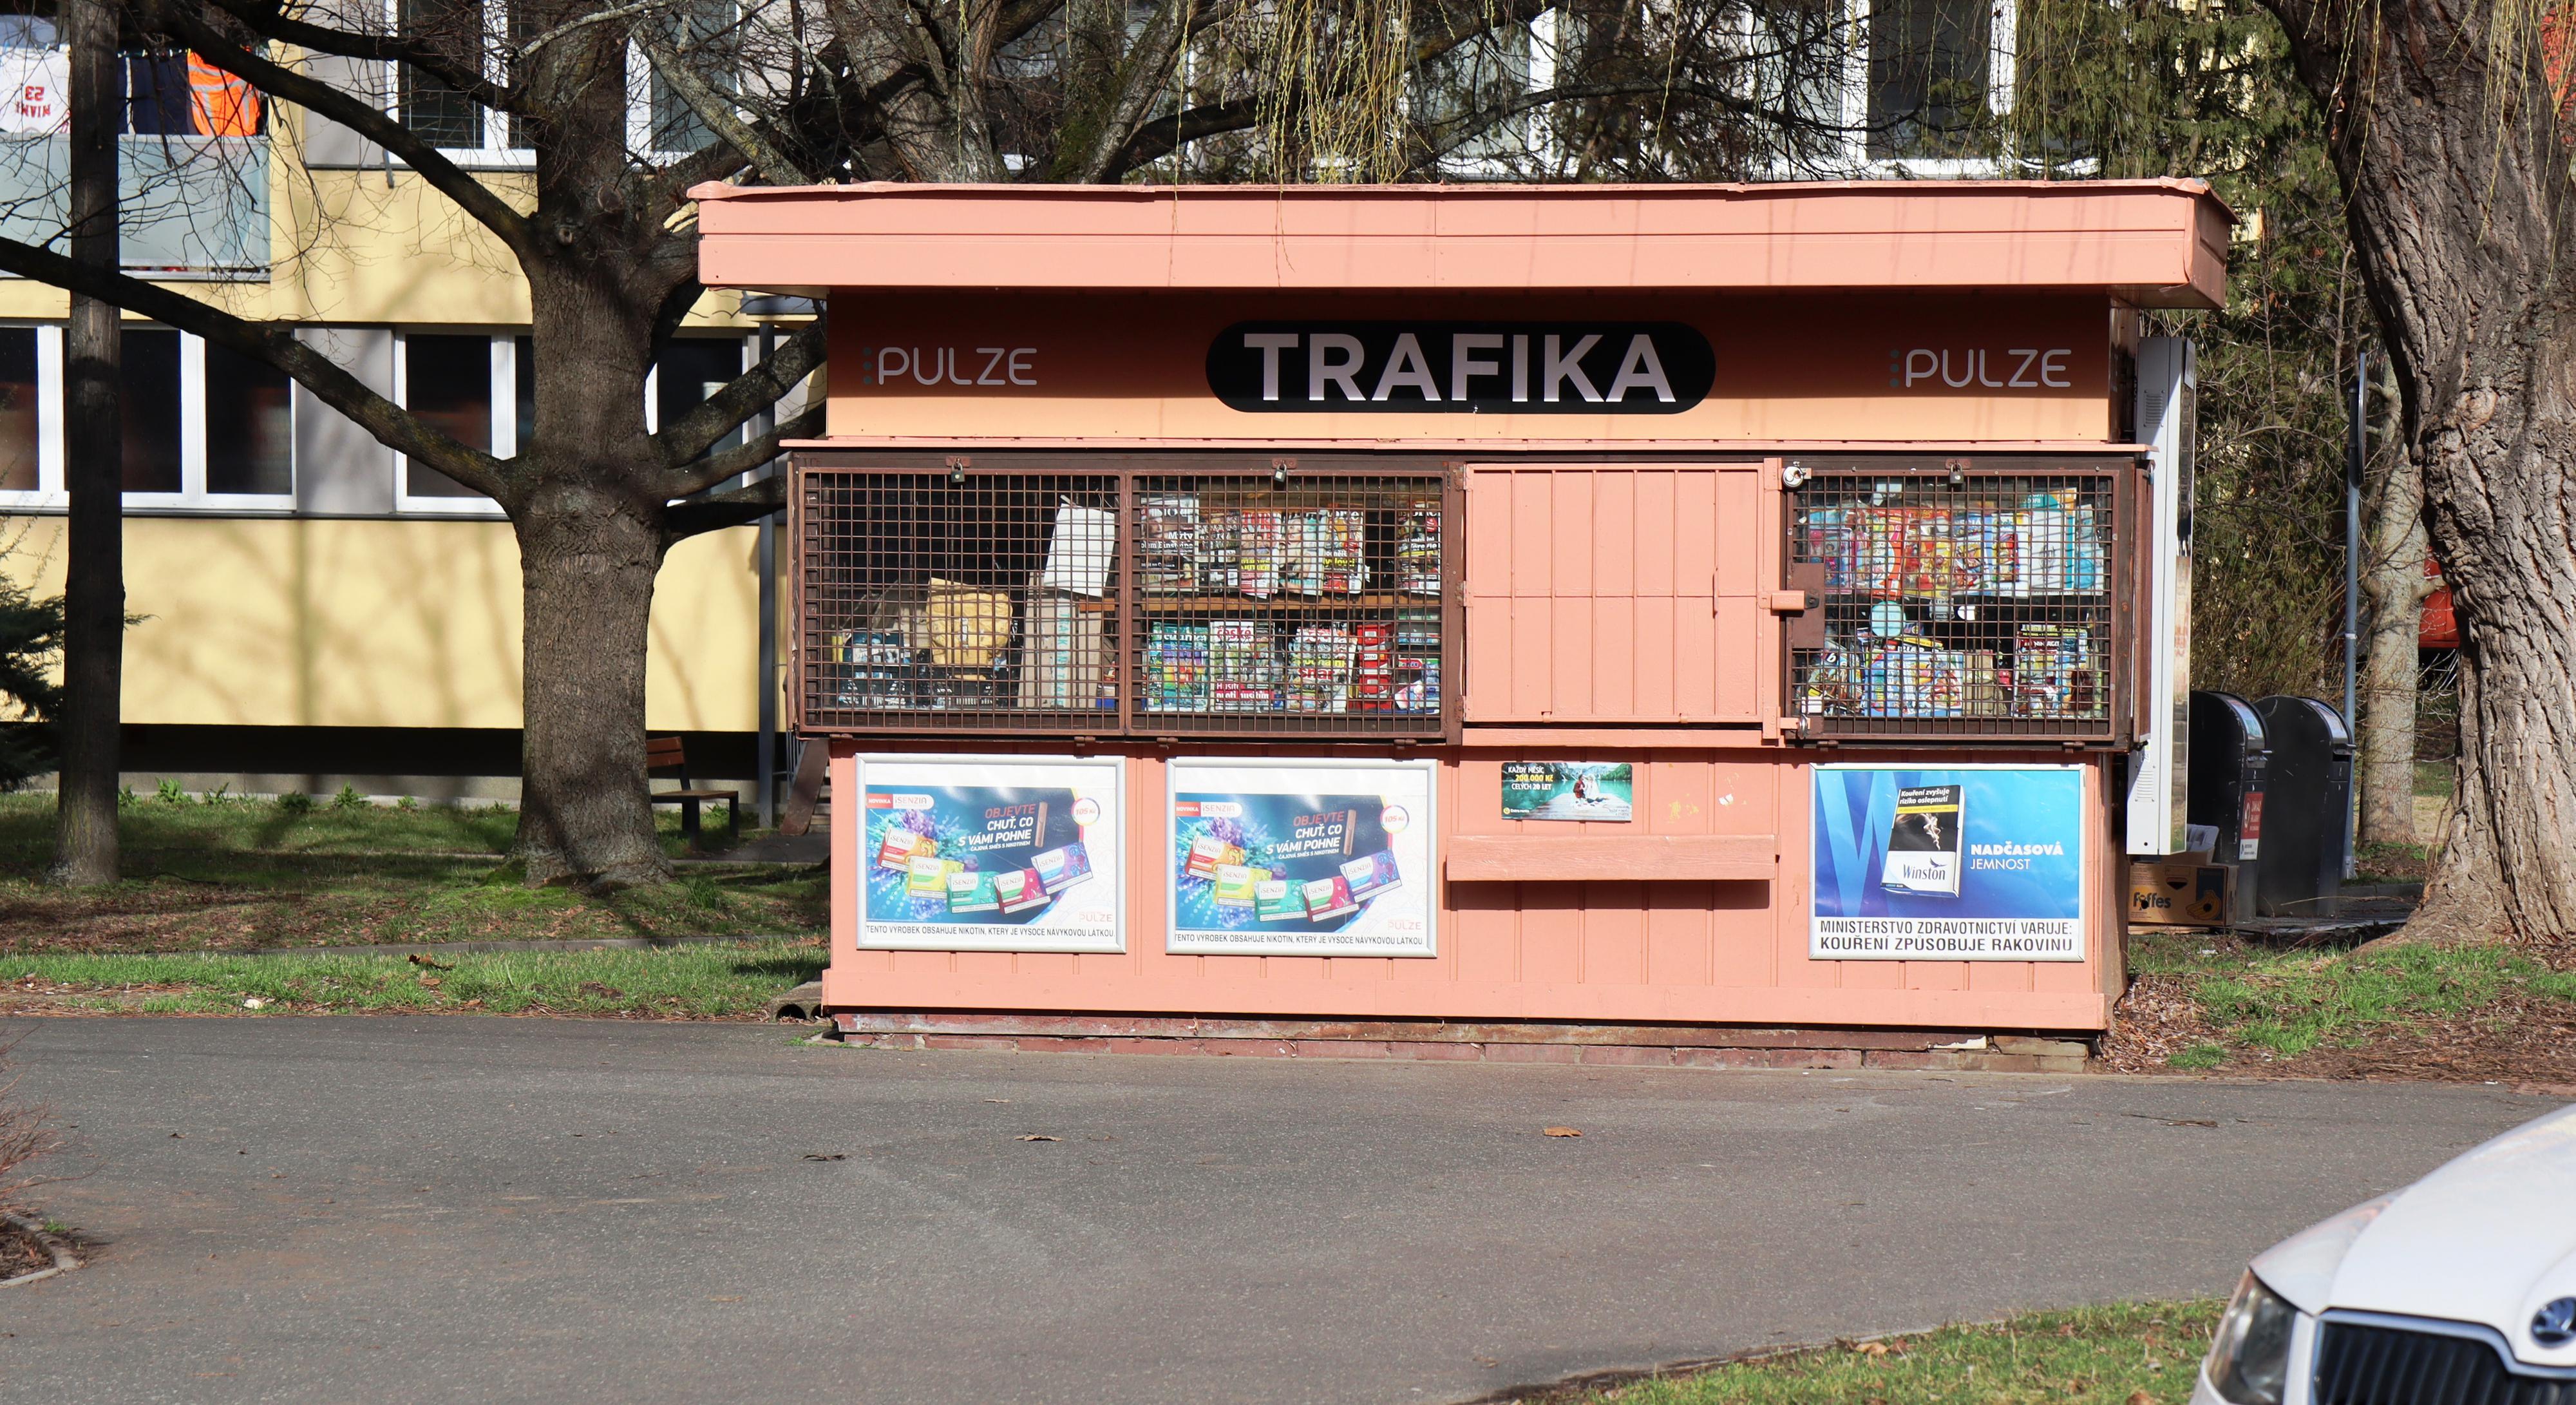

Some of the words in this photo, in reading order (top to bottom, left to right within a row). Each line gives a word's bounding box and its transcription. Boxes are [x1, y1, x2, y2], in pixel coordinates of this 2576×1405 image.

[24, 86, 44, 101] 23
[878, 347, 1037, 385] PULZE
[1244, 333, 1676, 403] TRAFIKA
[1906, 349, 2071, 388] PULZE
[1917, 796, 1949, 805] oslepnutí
[985, 804, 1036, 819] OBJEVTE
[1293, 811, 1345, 827] OBJEVTE
[987, 816, 1016, 831] CHUŤ,
[1019, 817, 1034, 827] CO
[958, 837, 965, 846] S
[969, 832, 994, 846] VÁMI
[996, 830, 1032, 842] POHNE
[1295, 824, 1325, 839] CHUŤ,
[1327, 824, 1342, 835] CO
[1266, 845, 1274, 854] S
[1277, 839, 1302, 853] VÁMI
[1303, 837, 1340, 850] POHNE
[1971, 841, 2064, 855] NADČASOVÁ
[1903, 863, 1946, 881] Winston
[1970, 859, 2031, 870] JEMNOST
[889, 924, 920, 933] VÝROBEK
[958, 927, 987, 935] NIKOTIN,
[989, 926, 1009, 935] KTERÝ
[1046, 927, 1086, 937] NÁVYKOVOU
[1821, 921, 1913, 933] MINISTERSTVO
[1917, 919, 2016, 934] ZDRAVOTNICTVÍ
[2021, 922, 2072, 935] VARUJE:
[1197, 933, 1228, 942] VÝROBEK
[1266, 935, 1294, 944] NIKOTIN,
[1296, 935, 1316, 943] KTERÝ
[1355, 935, 1395, 944] NÁVYKOVOU
[1821, 935, 1889, 950] KOUŘENÍ
[1895, 935, 1985, 951] ZPŮSOBUJE
[1992, 939, 2072, 951] RAKOVINU
